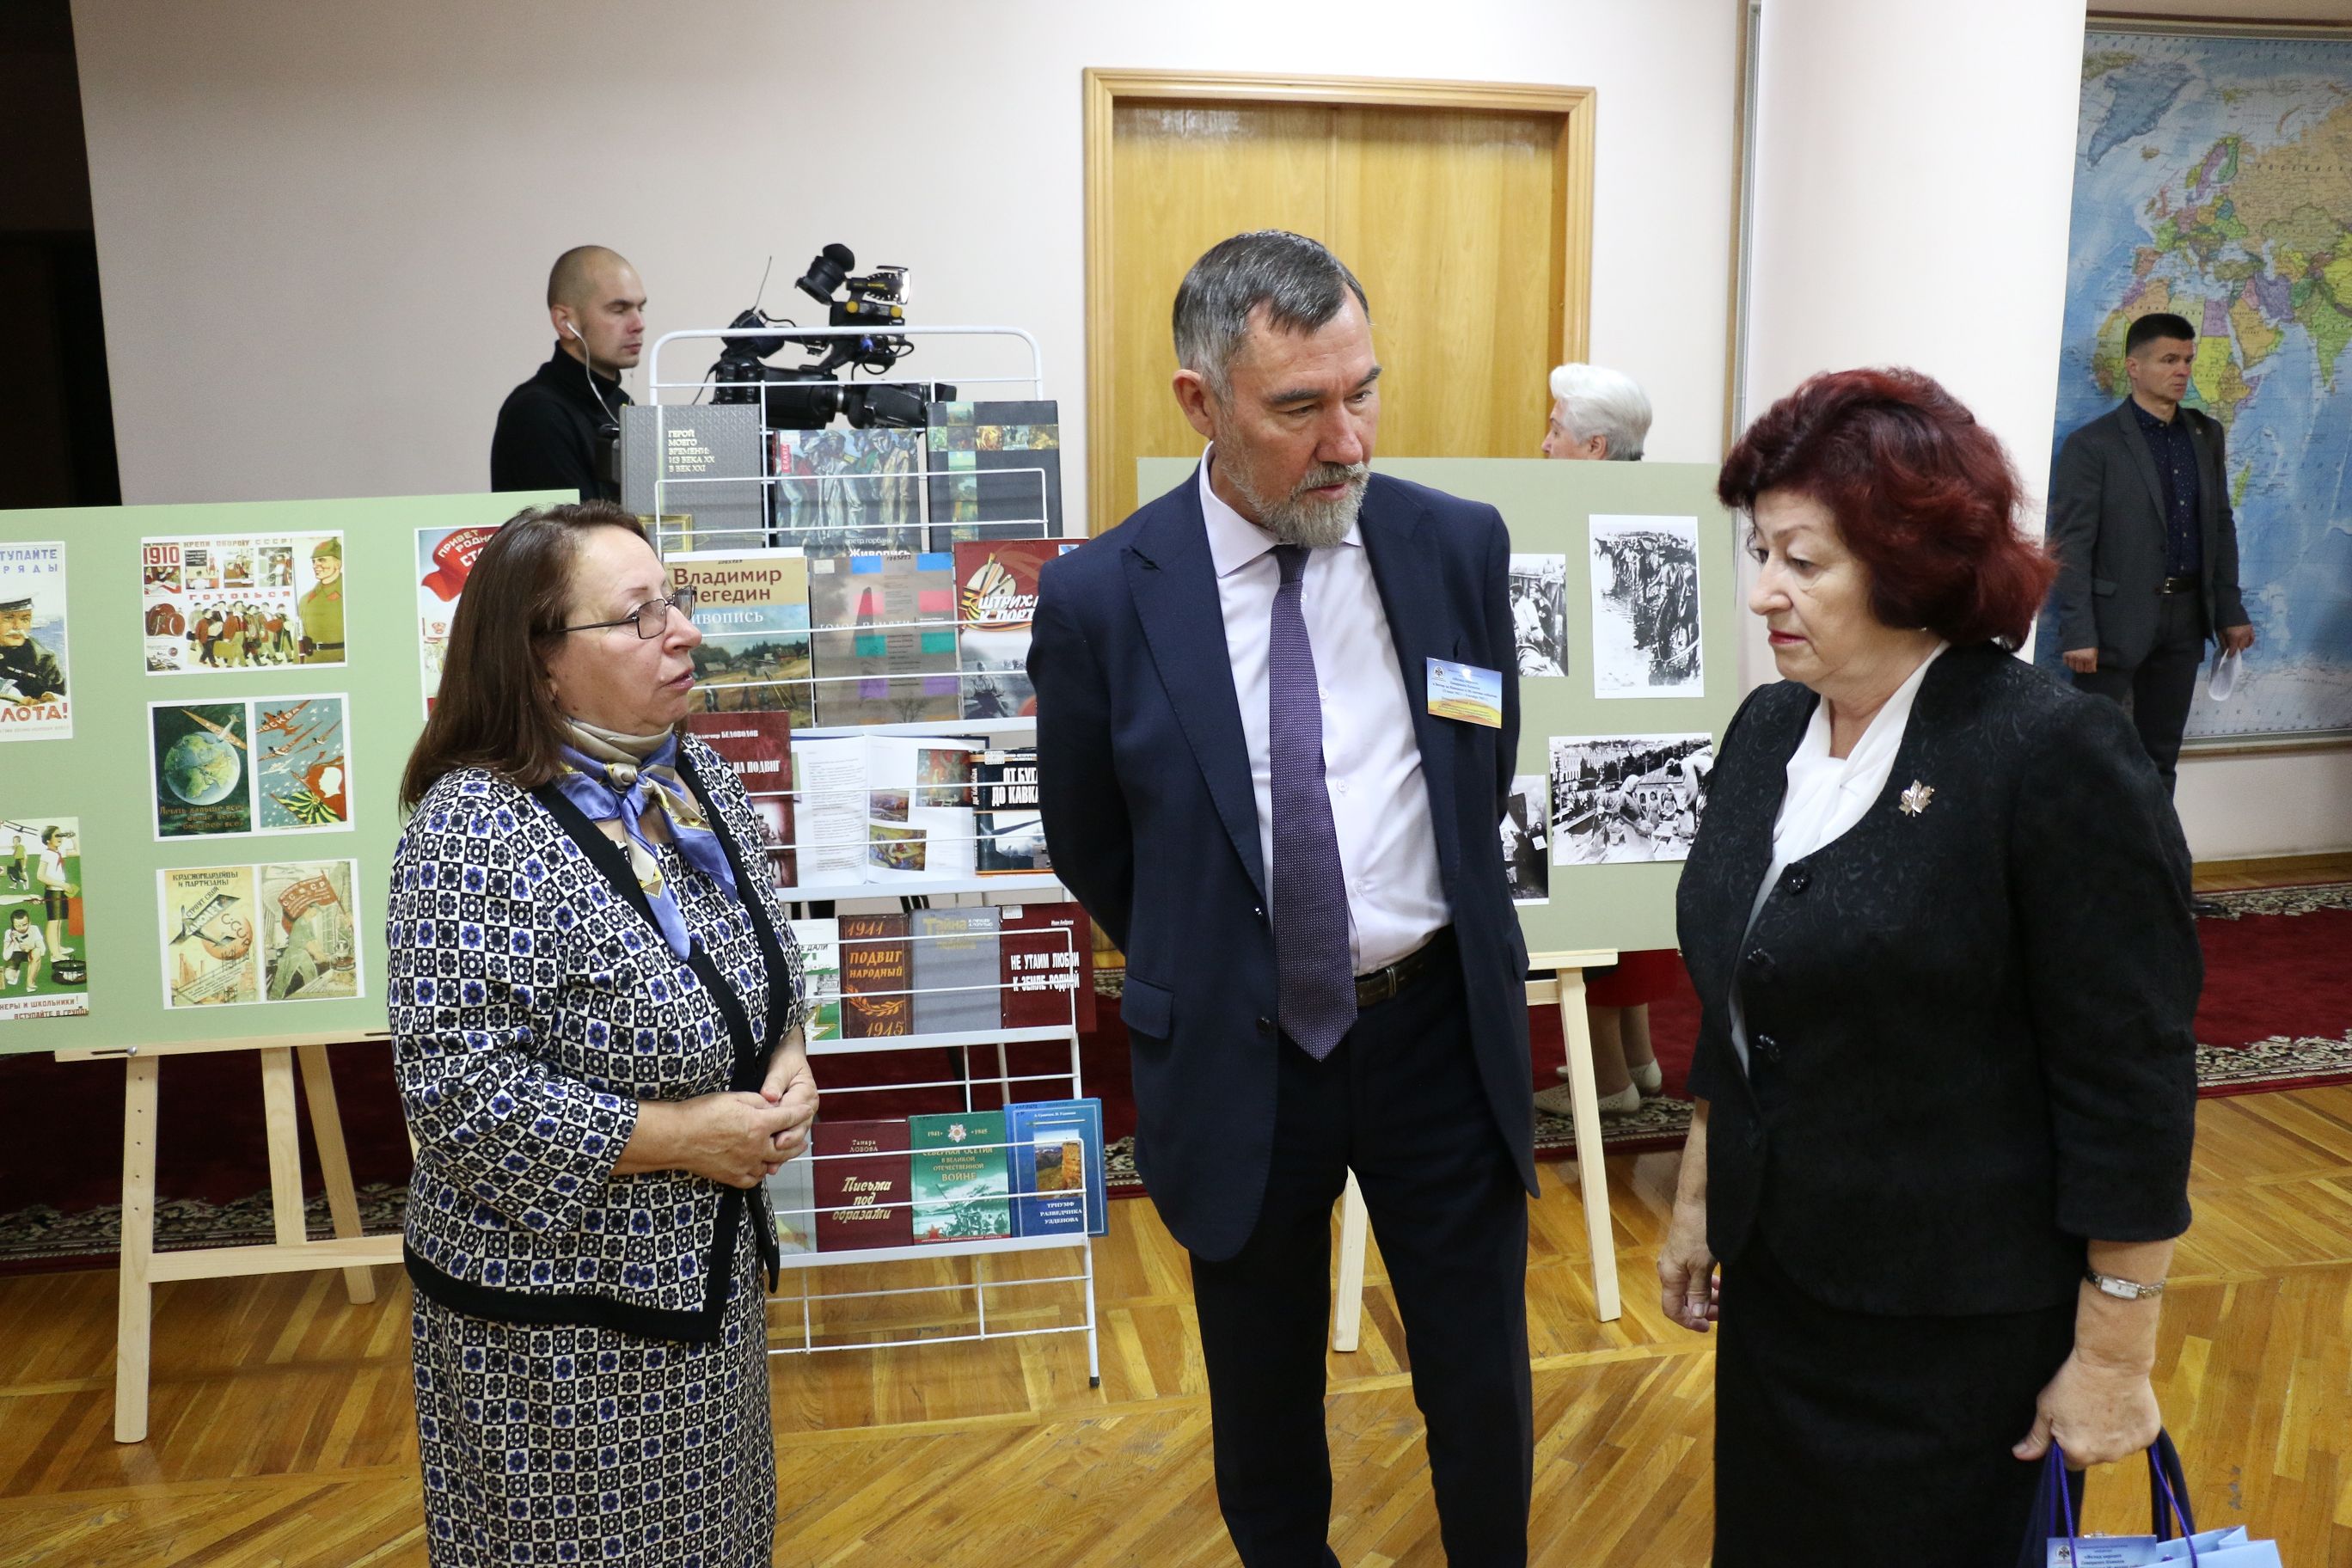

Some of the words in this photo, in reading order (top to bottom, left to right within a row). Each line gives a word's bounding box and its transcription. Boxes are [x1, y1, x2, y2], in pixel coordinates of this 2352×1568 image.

[668, 429, 695, 438] ГЕРОЙ
[668, 438, 698, 447] МОЕГО
[438, 529, 478, 558] ПРИВЕТ
[0, 548, 58, 561] ТУПАЙТЕ
[144, 547, 180, 565] 1910
[674, 568, 782, 585] Владимир
[674, 586, 771, 603] егедин
[1, 702, 68, 722] ЛОТА!
[747, 760, 781, 774] ПОДВИГ
[1018, 767, 1038, 783] БУГ
[992, 787, 1006, 806] ДО
[849, 951, 903, 966] ПОДВИГ
[1010, 955, 1021, 970] НЕ
[1024, 953, 1050, 970] УТАИМ
[849, 966, 903, 979] НАРОДНЫЙ
[842, 1176, 892, 1192] Письма
[942, 1172, 977, 1182] ВОЙНЕ
[854, 1191, 876, 1206] под
